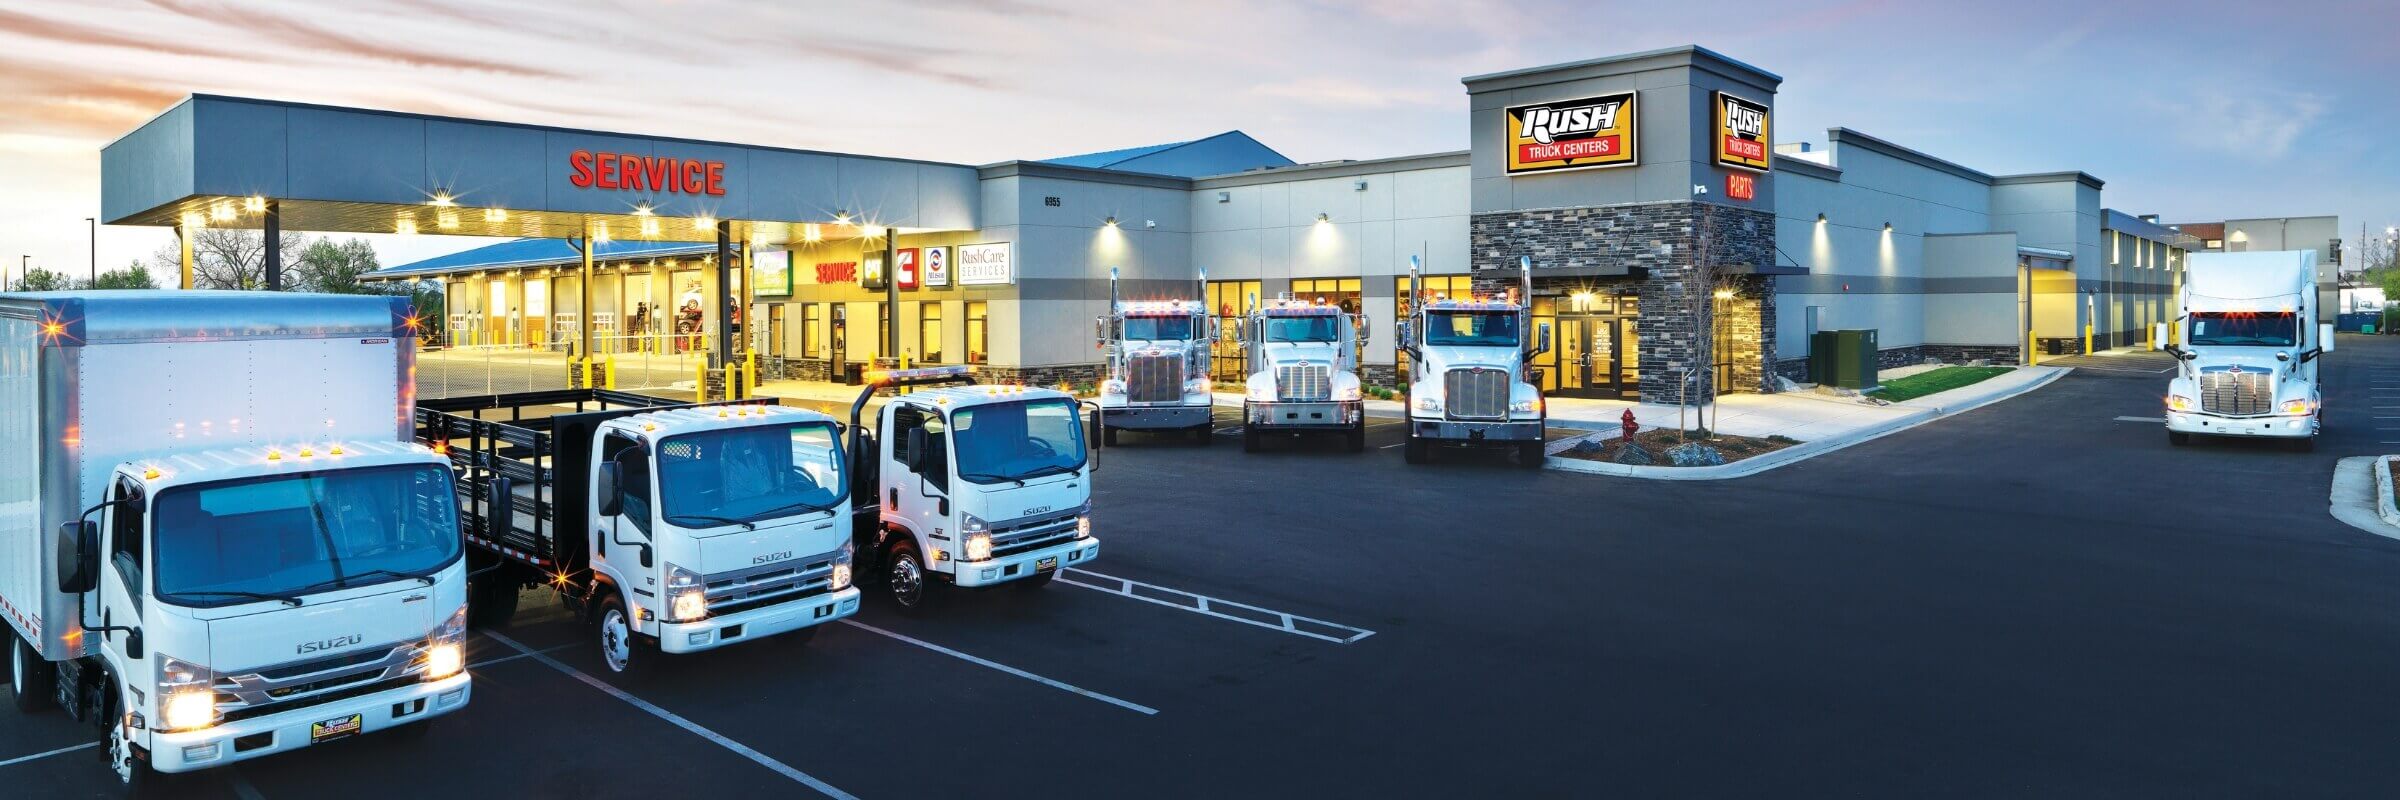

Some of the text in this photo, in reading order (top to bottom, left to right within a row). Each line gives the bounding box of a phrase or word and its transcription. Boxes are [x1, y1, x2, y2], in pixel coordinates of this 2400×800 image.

[1520, 102, 1619, 144] RUSH
[1726, 99, 1764, 139] RUSH
[1529, 140, 1609, 158] TRUCK CENTERS
[1729, 139, 1761, 157] TRUCK CENTERS
[569, 150, 725, 195] SERVICE
[1728, 175, 1753, 200] PARTS
[1045, 196, 1061, 207] 6955
[962, 249, 1005, 264] RushCare
[816, 262, 857, 284] SERVICE
[962, 265, 1005, 276] SERVICES
[1024, 505, 1051, 516] ISUZU
[753, 551, 792, 564] ISUZU
[297, 634, 362, 654] ISUZU
